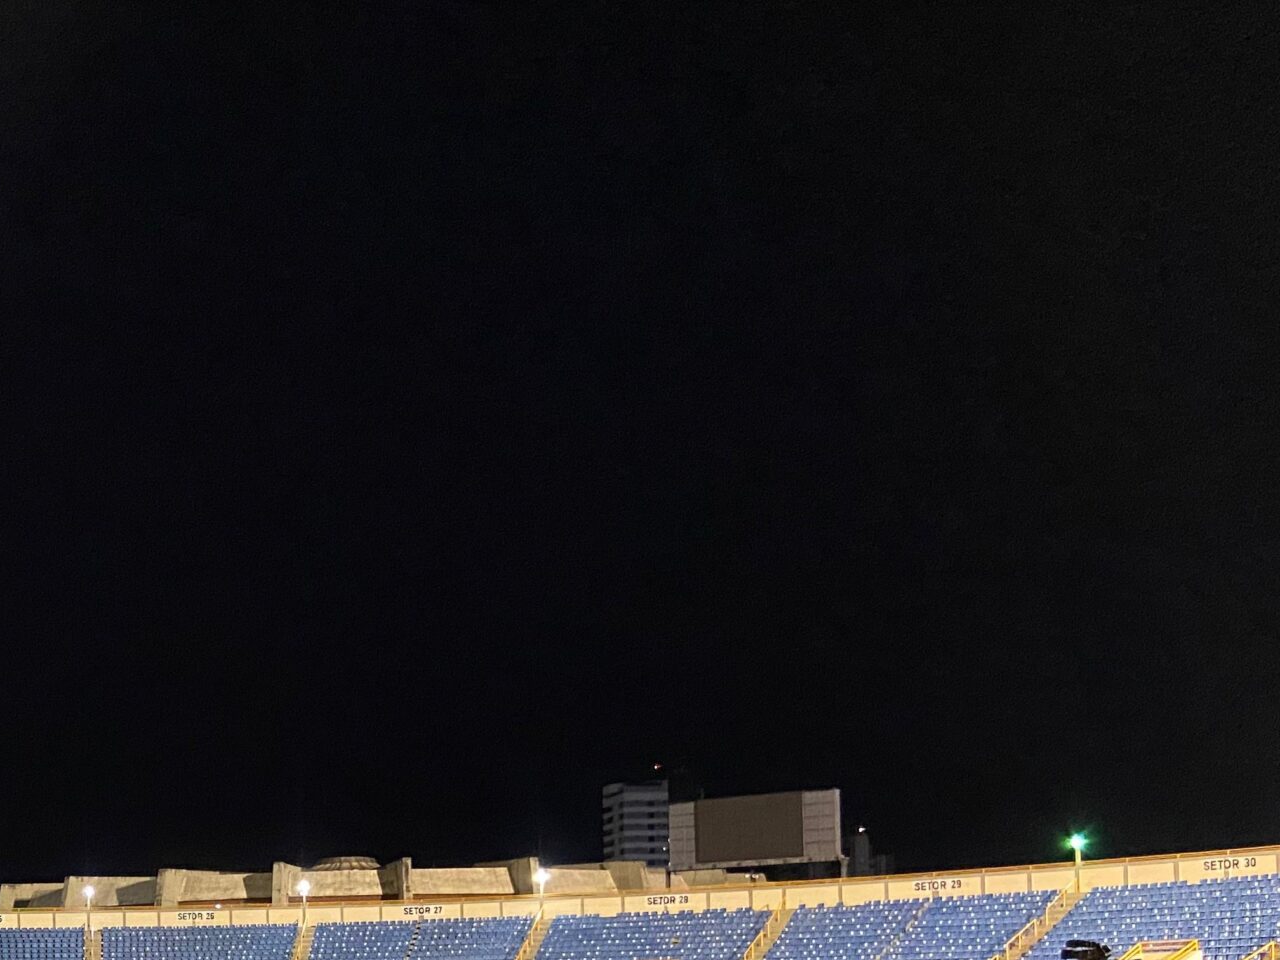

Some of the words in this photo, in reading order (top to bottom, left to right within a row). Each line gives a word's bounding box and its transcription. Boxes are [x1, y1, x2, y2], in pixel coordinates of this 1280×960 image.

[1203, 859, 1240, 871] SETOR
[1244, 857, 1257, 868] 30
[914, 880, 947, 891] SETOR
[951, 879, 962, 889] 29
[647, 896, 676, 906] SETOR
[679, 895, 689, 904] 28
[403, 906, 431, 915] SETOR
[433, 906, 443, 914] 27
[177, 912, 203, 921] SETOR
